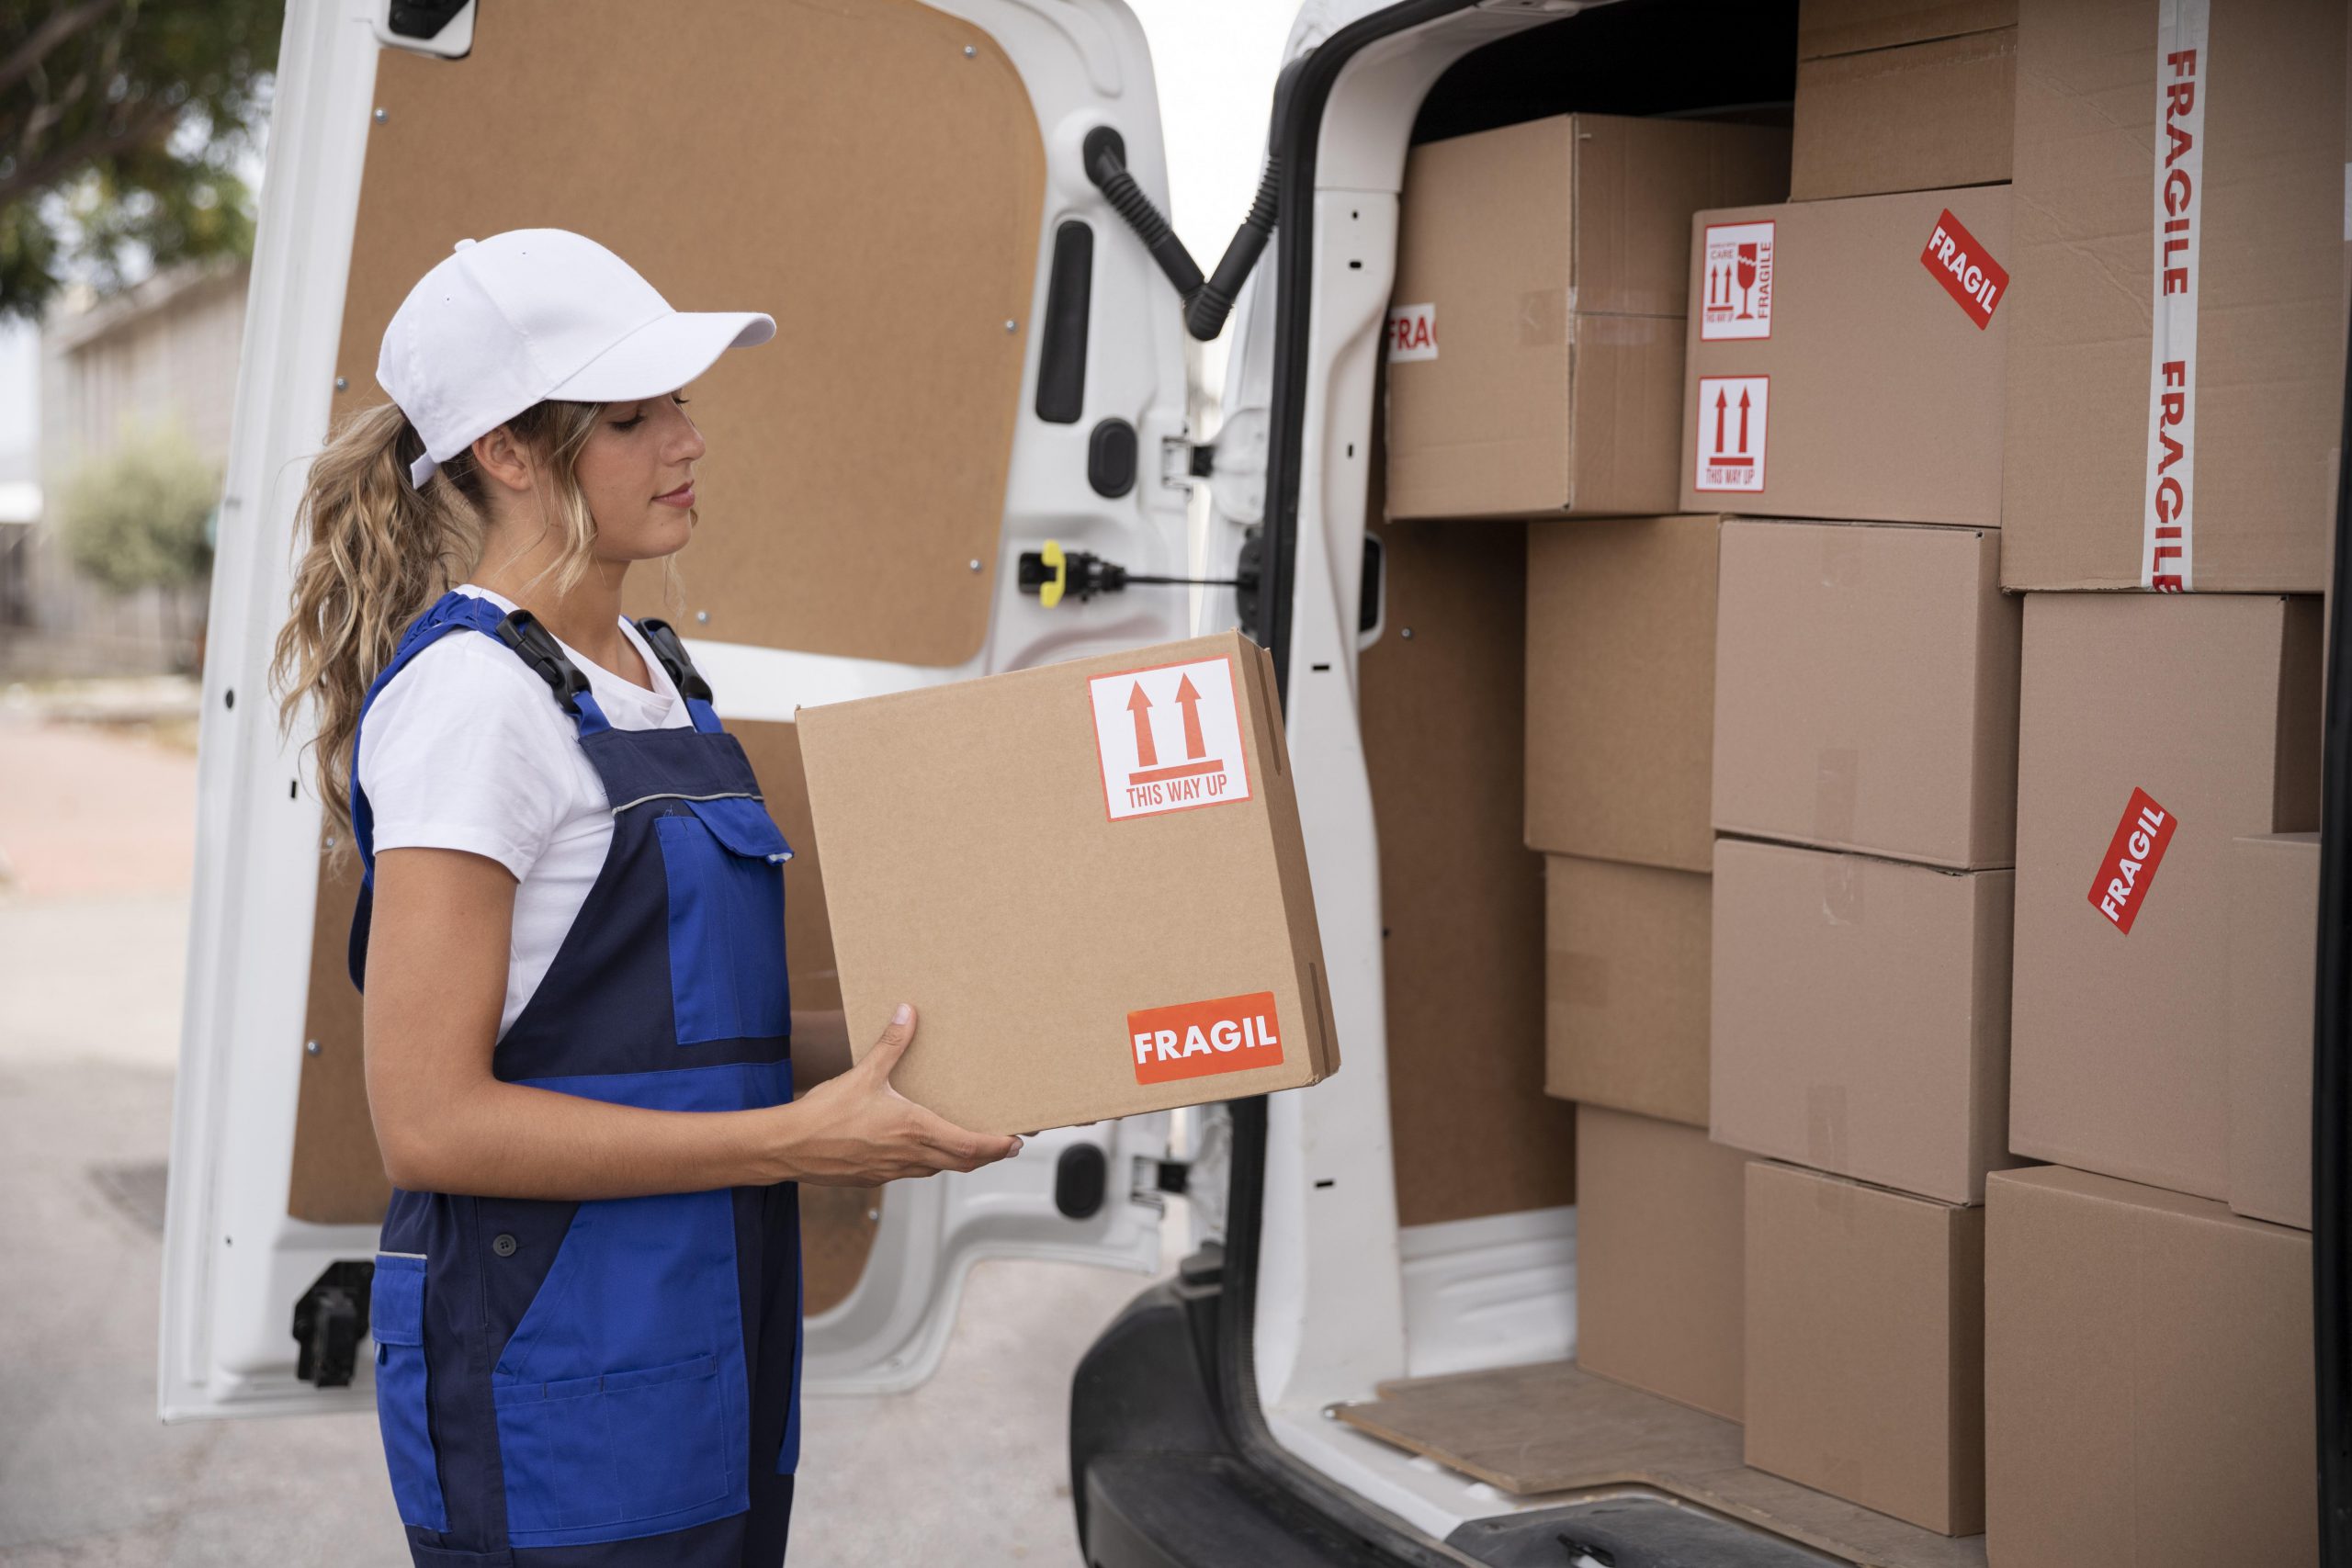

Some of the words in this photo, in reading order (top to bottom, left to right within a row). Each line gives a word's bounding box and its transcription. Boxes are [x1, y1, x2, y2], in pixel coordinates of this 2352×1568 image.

[2163, 49, 2197, 298] FRAGILE
[1711, 249, 1734, 259] CARE
[1758, 242, 1771, 319] FRAGILE
[1928, 226, 1996, 314] FRAGIL
[1388, 317, 1439, 351] FRA
[1706, 468, 1722, 485] THIS
[1725, 468, 1742, 485] WAY
[1744, 468, 1755, 485] UP
[2152, 360, 2186, 593] FRAGILE
[1126, 784, 1163, 808] THIS
[1166, 778, 1201, 802] WAY
[1206, 773, 1227, 796] UP
[2100, 807, 2165, 922] FRAGIL
[1134, 1015, 1277, 1065] FRAGIL
